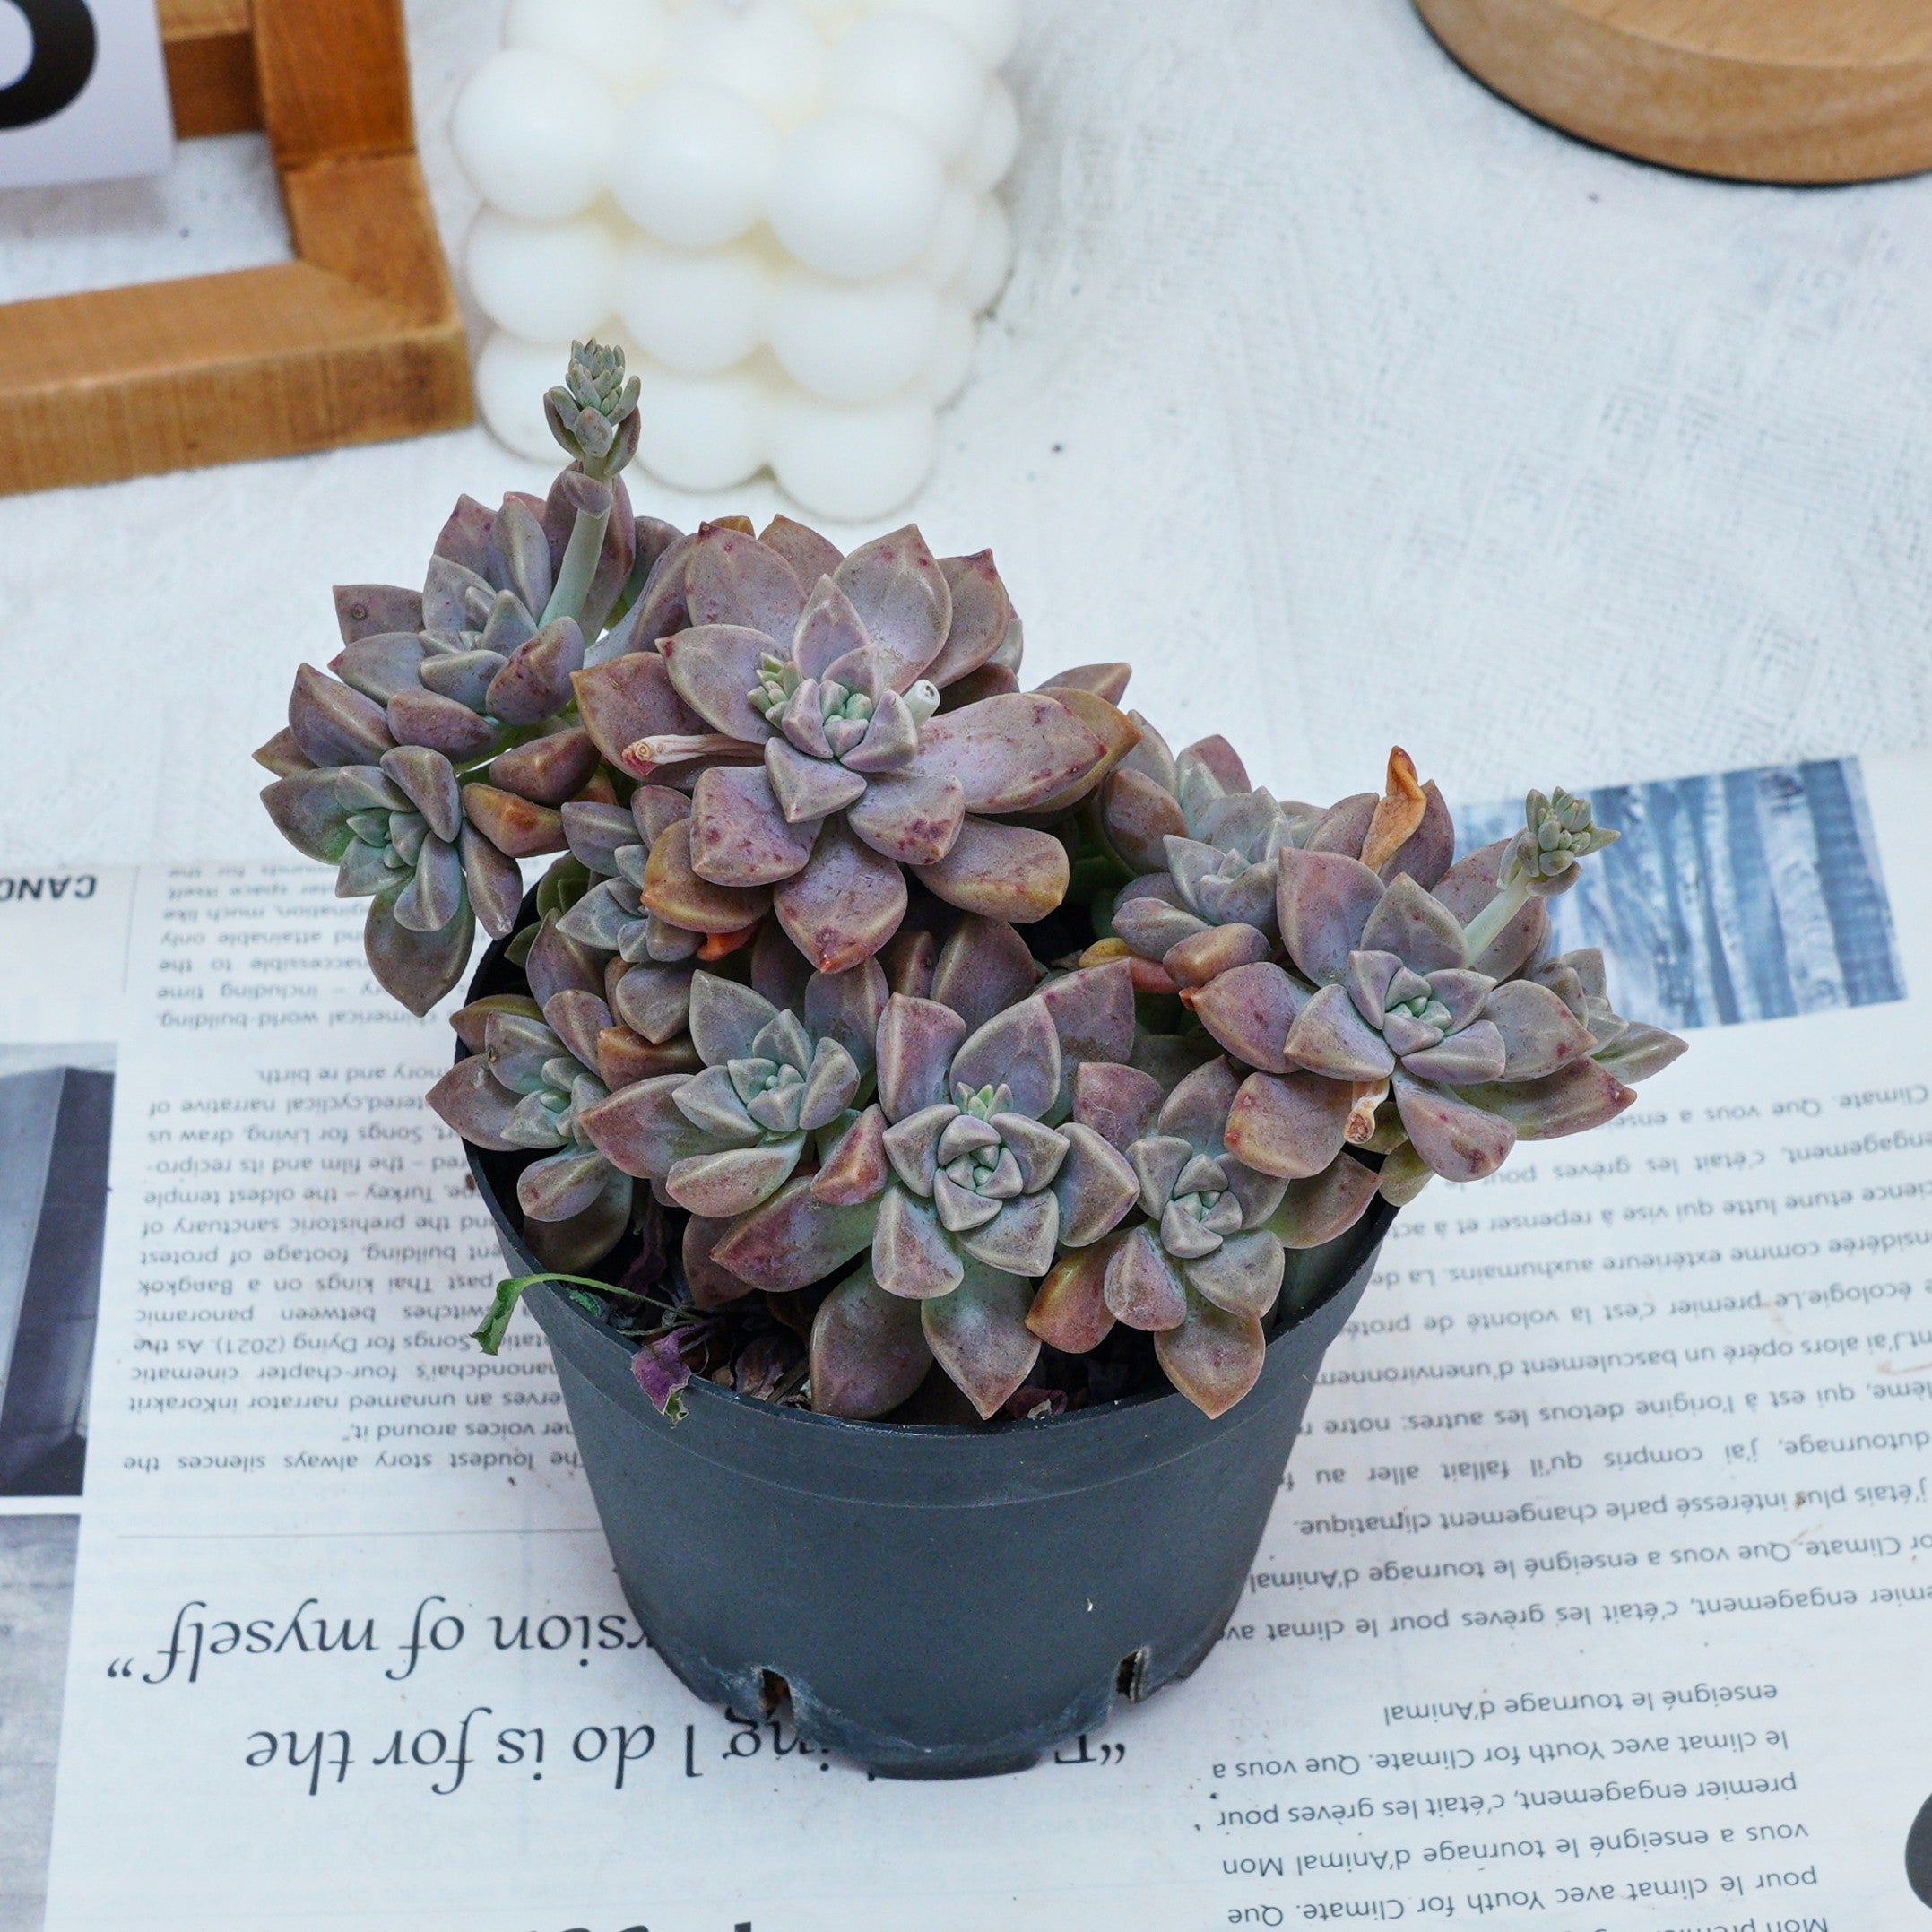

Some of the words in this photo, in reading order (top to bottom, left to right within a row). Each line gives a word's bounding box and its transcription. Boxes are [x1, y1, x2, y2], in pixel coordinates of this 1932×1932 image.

[138, 1276, 233, 1297] Bangkok
[274, 1278, 303, 1293] on
[316, 1272, 374, 1295] kings
[388, 1276, 434, 1295] Thai
[448, 1270, 494, 1291] past
[1604, 1301, 1656, 1321] c'est
[1669, 1289, 1763, 1315] premier
[136, 1304, 254, 1325] panoramic
[281, 1305, 376, 1323] between
[1424, 1314, 1454, 1336] de
[1467, 1308, 1559, 1333] volonté
[1571, 1306, 1592, 1326] la
[133, 1336, 169, 1356] the
[177, 1339, 204, 1355] As
[293, 1331, 358, 1355] Dying
[365, 1335, 396, 1355] for
[403, 1330, 470, 1353] Songs
[1723, 1337, 1794, 1365] opéré
[1800, 1335, 1859, 1357] alors
[1521, 1348, 1678, 1378] basculement
[1685, 1346, 1716, 1363] un
[131, 1365, 239, 1383] cinematic
[257, 1361, 397, 1383] four-chapter
[247, 1394, 339, 1412] narrator
[349, 1393, 456, 1413] unnamed
[465, 1391, 493, 1408] an
[1635, 1391, 1735, 1417] l'origine
[1769, 1389, 1806, 1408] est
[1816, 1382, 1856, 1408] qui
[1401, 1410, 1484, 1432] autres:
[1494, 1408, 1529, 1429] les
[1538, 1401, 1624, 1423] detous
[377, 1423, 458, 1442] around
[464, 1421, 536, 1441] voices
[1323, 1416, 1391, 1436] notre
[1724, 1436, 1758, 1465] j'ai
[1779, 1430, 1931, 1456] dutournage,
[123, 1456, 160, 1474] the
[178, 1454, 265, 1473] silences
[283, 1450, 359, 1473] always
[375, 1449, 432, 1470] story
[449, 1451, 535, 1474] loudest
[1529, 1450, 1583, 1479] qu'il
[1603, 1444, 1703, 1472] compris
[1315, 1467, 1347, 1486] au
[1366, 1464, 1420, 1486] aller
[1440, 1459, 1510, 1484] fallait
[1793, 1483, 1847, 1510] plus
[1854, 1477, 1927, 1506] j'étais
[1439, 1502, 1598, 1531] changement
[1606, 1494, 1668, 1522] parle
[1676, 1491, 1788, 1520] intéressé
[1294, 1508, 1432, 1538] climatique.
[1669, 1546, 1730, 1564] vous
[1738, 1541, 1791, 1564] Que
[1799, 1535, 1902, 1558] Climate.
[1368, 1559, 1486, 1586] tournage
[1493, 1558, 1516, 1581] le
[1524, 1549, 1639, 1580] enseigné
[1250, 1566, 1360, 1595] d'Animal
[1601, 1599, 1679, 1625] c'était
[1690, 1585, 1858, 1617] engagement,
[1356, 1617, 1379, 1639] le
[1389, 1608, 1450, 1633] pour
[1460, 1602, 1546, 1631] grèves
[1555, 1606, 1591, 1628] les
[385, 1595, 464, 1681] of
[1266, 1618, 1346, 1642] climat
[1504, 1691, 1624, 1714] tournage
[1632, 1691, 1655, 1712] le
[1661, 1681, 1778, 1711] enseigné
[1383, 1699, 1496, 1728] d'Animal
[372, 1706, 492, 1796] for
[1611, 1737, 1669, 1755] avec
[1677, 1730, 1757, 1754] climat
[1765, 1729, 1789, 1751] le
[246, 1730, 353, 1796] the
[498, 1728, 544, 1781] is
[572, 1724, 655, 1790] do
[1368, 1747, 1476, 1772] Climate.
[1483, 1745, 1521, 1767] for
[1529, 1740, 1606, 1764] Youth
[1235, 1758, 1298, 1779] vous
[1305, 1753, 1360, 1777] Que
[1513, 1778, 1688, 1810] engagement,
[1696, 1770, 1798, 1802] premier
[1217, 1802, 1279, 1828] pour
[1287, 1796, 1374, 1827] grèves
[1382, 1799, 1418, 1821] les
[1425, 1792, 1505, 1819] c'était
[1590, 1827, 1709, 1858] enseigné
[1746, 1823, 1809, 1842] vous
[1423, 1839, 1546, 1864] tournage
[1555, 1838, 1580, 1859] le
[1222, 1856, 1284, 1878] Mon
[1296, 1848, 1411, 1877] d'Animal
[1720, 1875, 1744, 1897] le
[1755, 1864, 1818, 1890] pour
[1555, 1884, 1616, 1904] avec
[1627, 1876, 1709, 1902] climat
[1295, 1898, 1405, 1923] Climate.
[1417, 1895, 1456, 1918] for
[1467, 1890, 1546, 1915] Youth
[1227, 1903, 1284, 1928] Que
